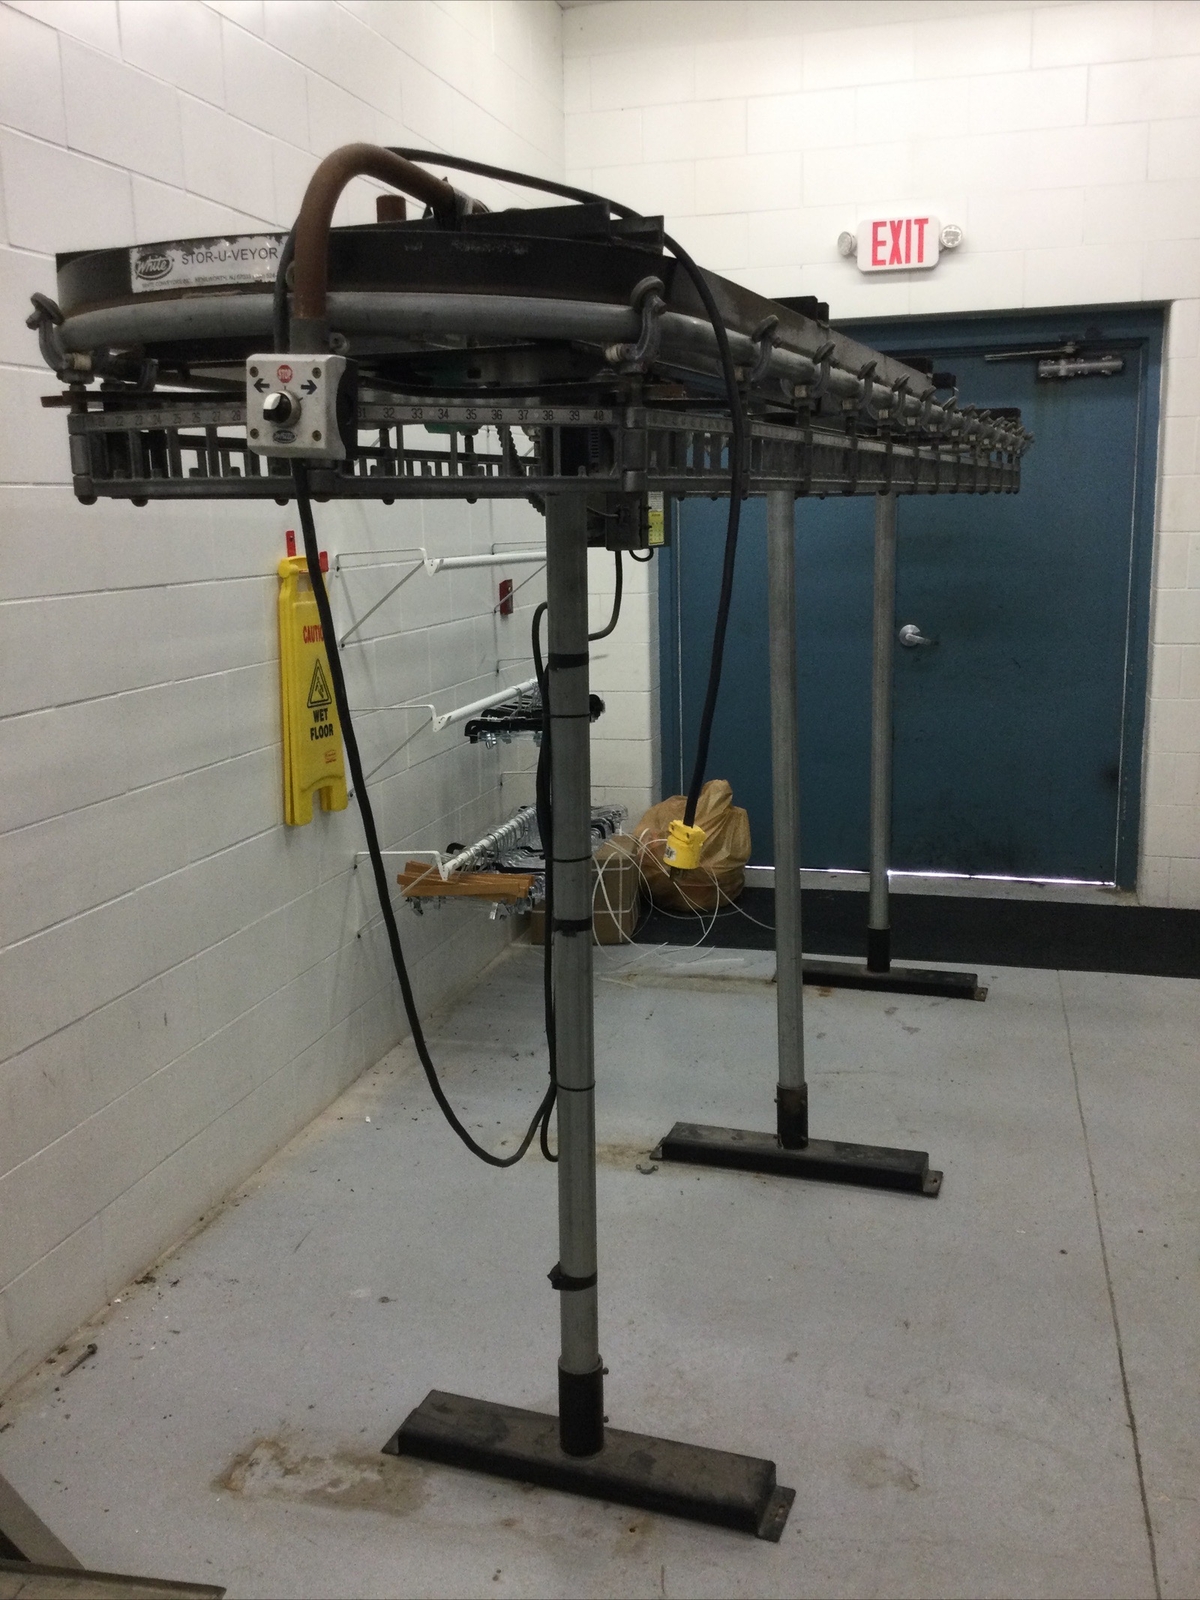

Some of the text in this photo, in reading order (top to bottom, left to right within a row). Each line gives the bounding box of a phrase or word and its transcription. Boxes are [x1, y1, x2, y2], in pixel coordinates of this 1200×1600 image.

[871, 218, 929, 266] EXIT
[136, 255, 169, 274] White
[181, 247, 279, 265] STOR-U-VEYOR
[115, 415, 124, 427] 22
[135, 414, 143, 426] 23
[153, 413, 162, 425] 24
[173, 413, 182, 424] 25
[192, 412, 201, 423] 26
[212, 411, 221, 422] 27
[232, 410, 241, 421] 28
[383, 407, 395, 419] 32
[411, 407, 423, 419] 33
[438, 408, 449, 420] 34
[466, 409, 477, 420] 35
[491, 409, 503, 421] 36
[518, 410, 529, 421] 37
[542, 410, 554, 421] 38
[569, 410, 580, 421] 39
[593, 410, 604, 421] 40
[303, 625, 325, 644] CAUTIO
[313, 708, 328, 723] WET
[310, 723, 334, 741] FLOOR
